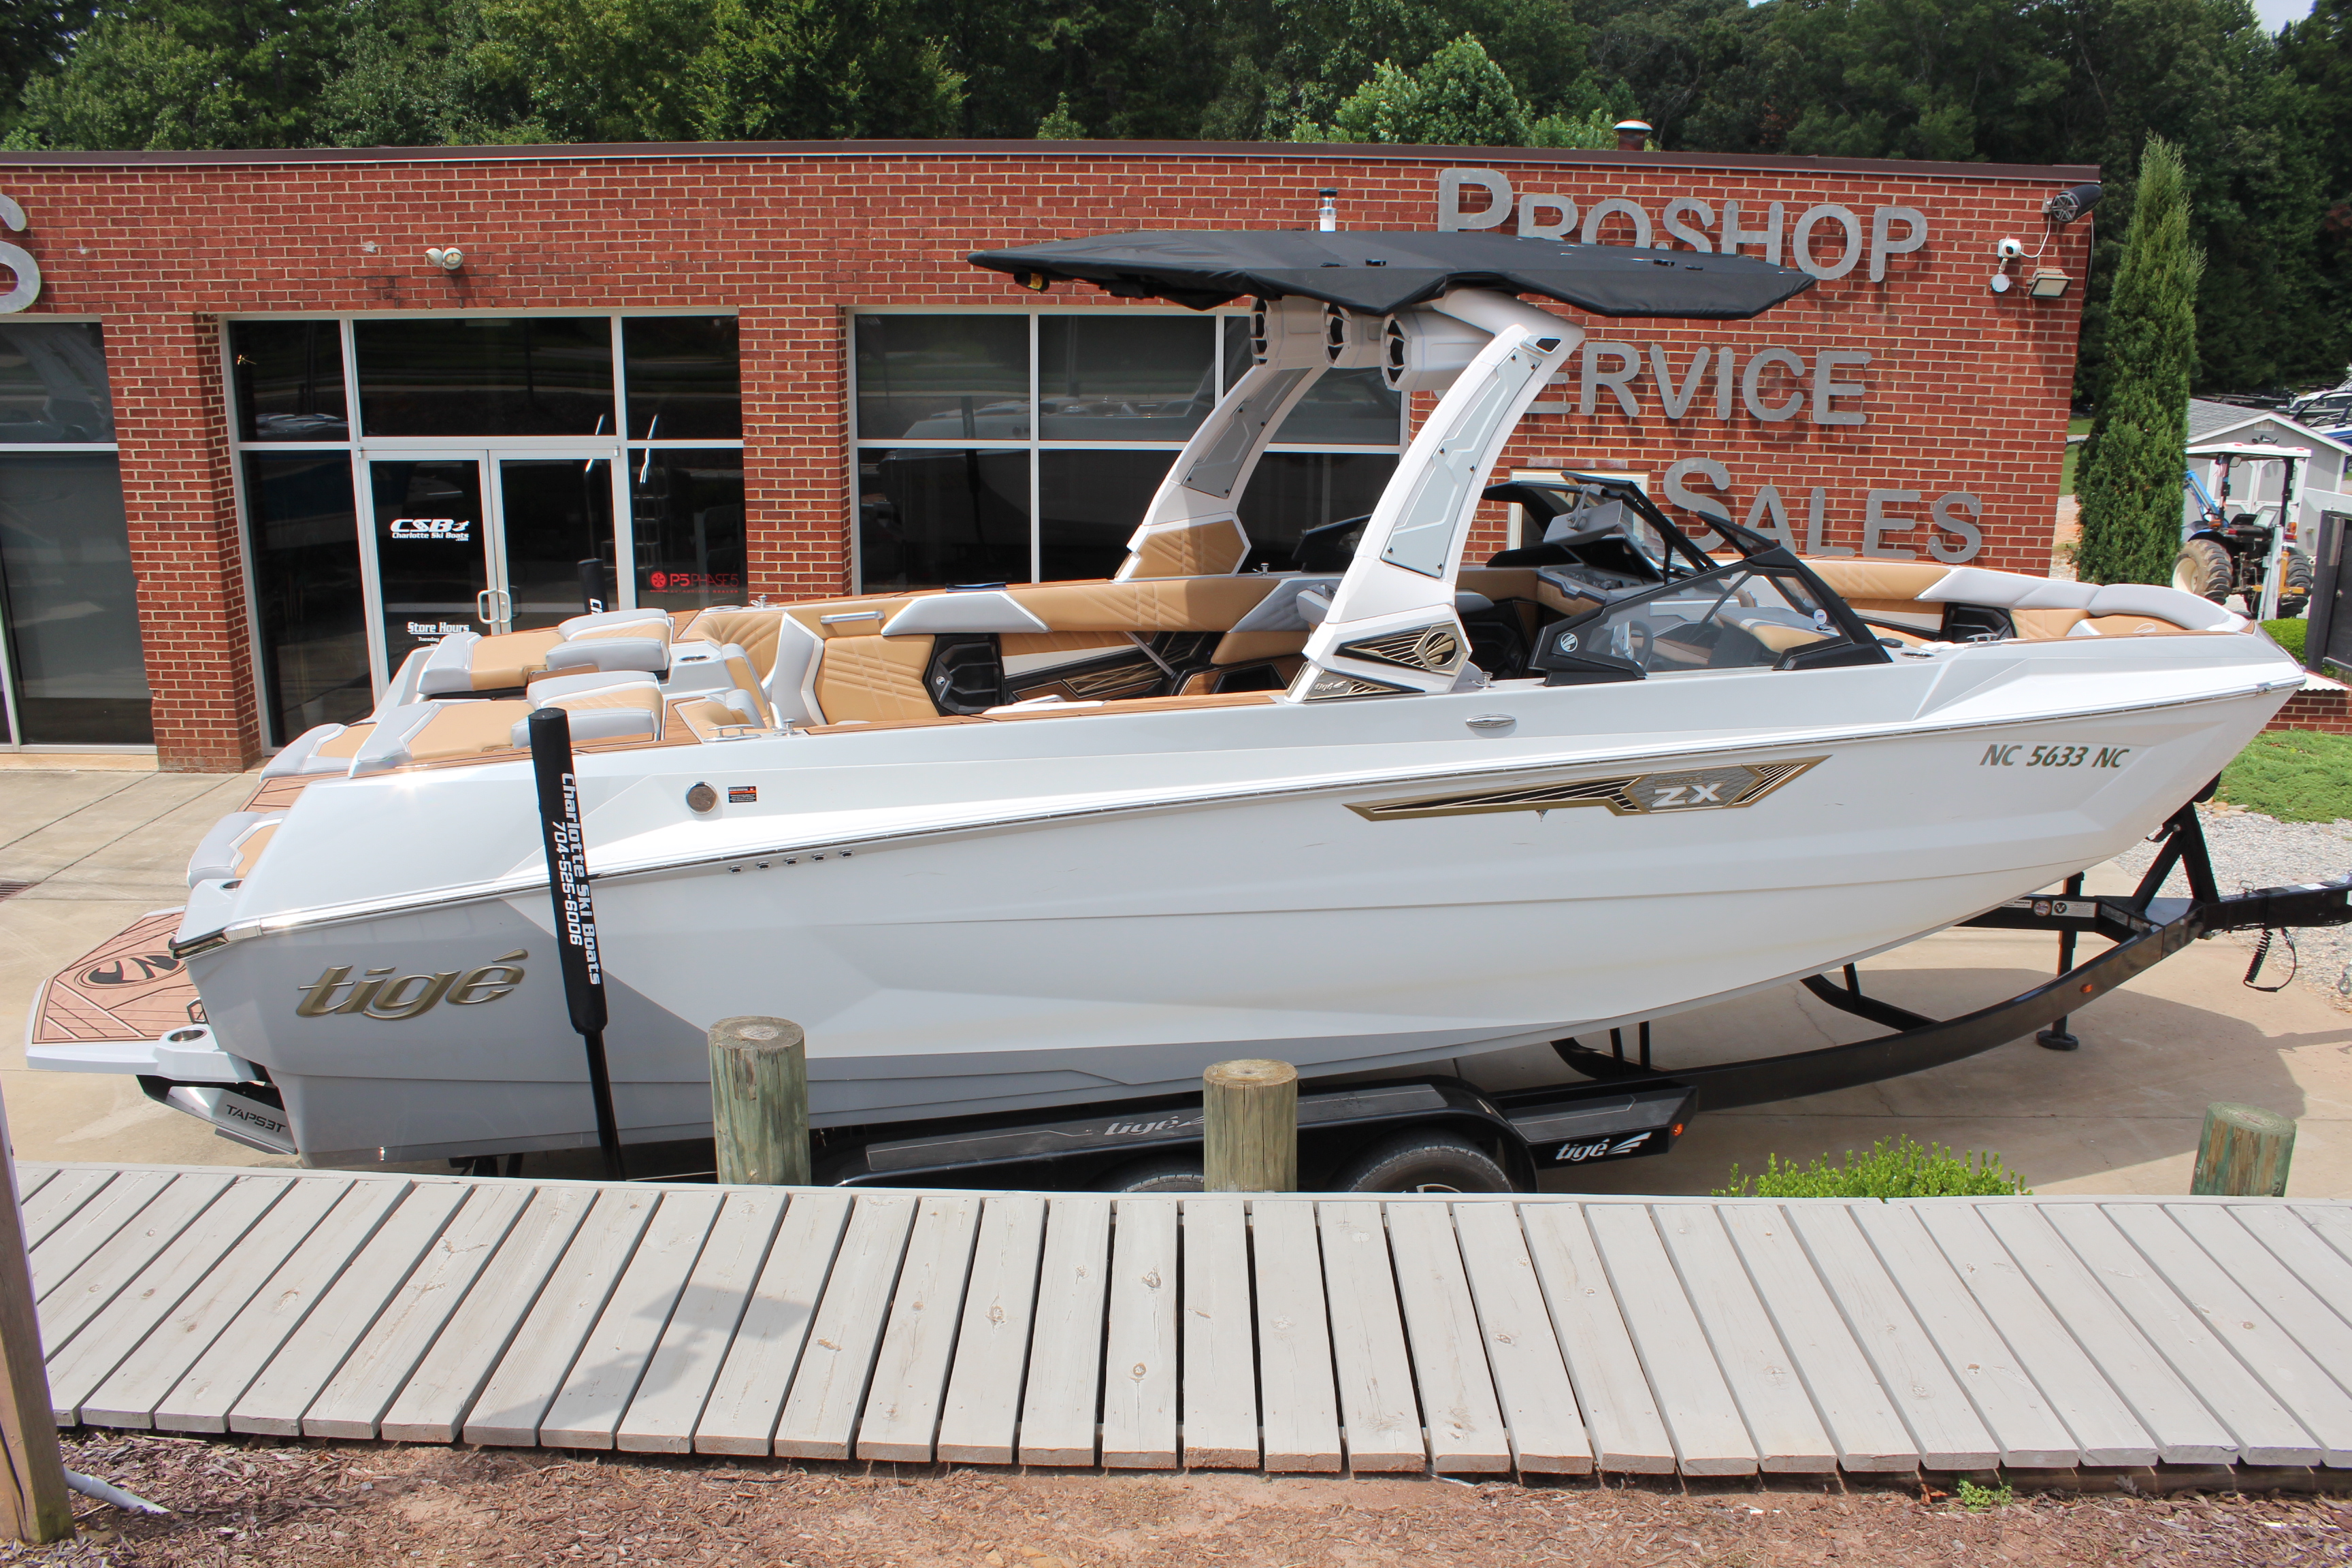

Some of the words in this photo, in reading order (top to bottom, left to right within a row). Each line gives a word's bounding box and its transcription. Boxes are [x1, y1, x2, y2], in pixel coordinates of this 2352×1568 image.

[1663, 457, 1982, 564] SALES
[390, 518, 455, 533] CSB
[407, 621, 436, 633] Store
[439, 621, 470, 633] Hours
[1979, 744, 2023, 766] NC
[2026, 745, 2089, 767] 5633
[2091, 747, 2130, 768] NC
[1651, 780, 1728, 808] ZX
[561, 772, 586, 878] Charlotte
[553, 821, 583, 947] 704-525-6006
[576, 883, 593, 917] Ski
[581, 923, 600, 985] Boats
[296, 947, 529, 1021] tigé
[227, 1105, 286, 1132] TAPS3T
[1104, 1115, 1179, 1136] tigé
[1556, 1139, 1610, 1161] tigé
